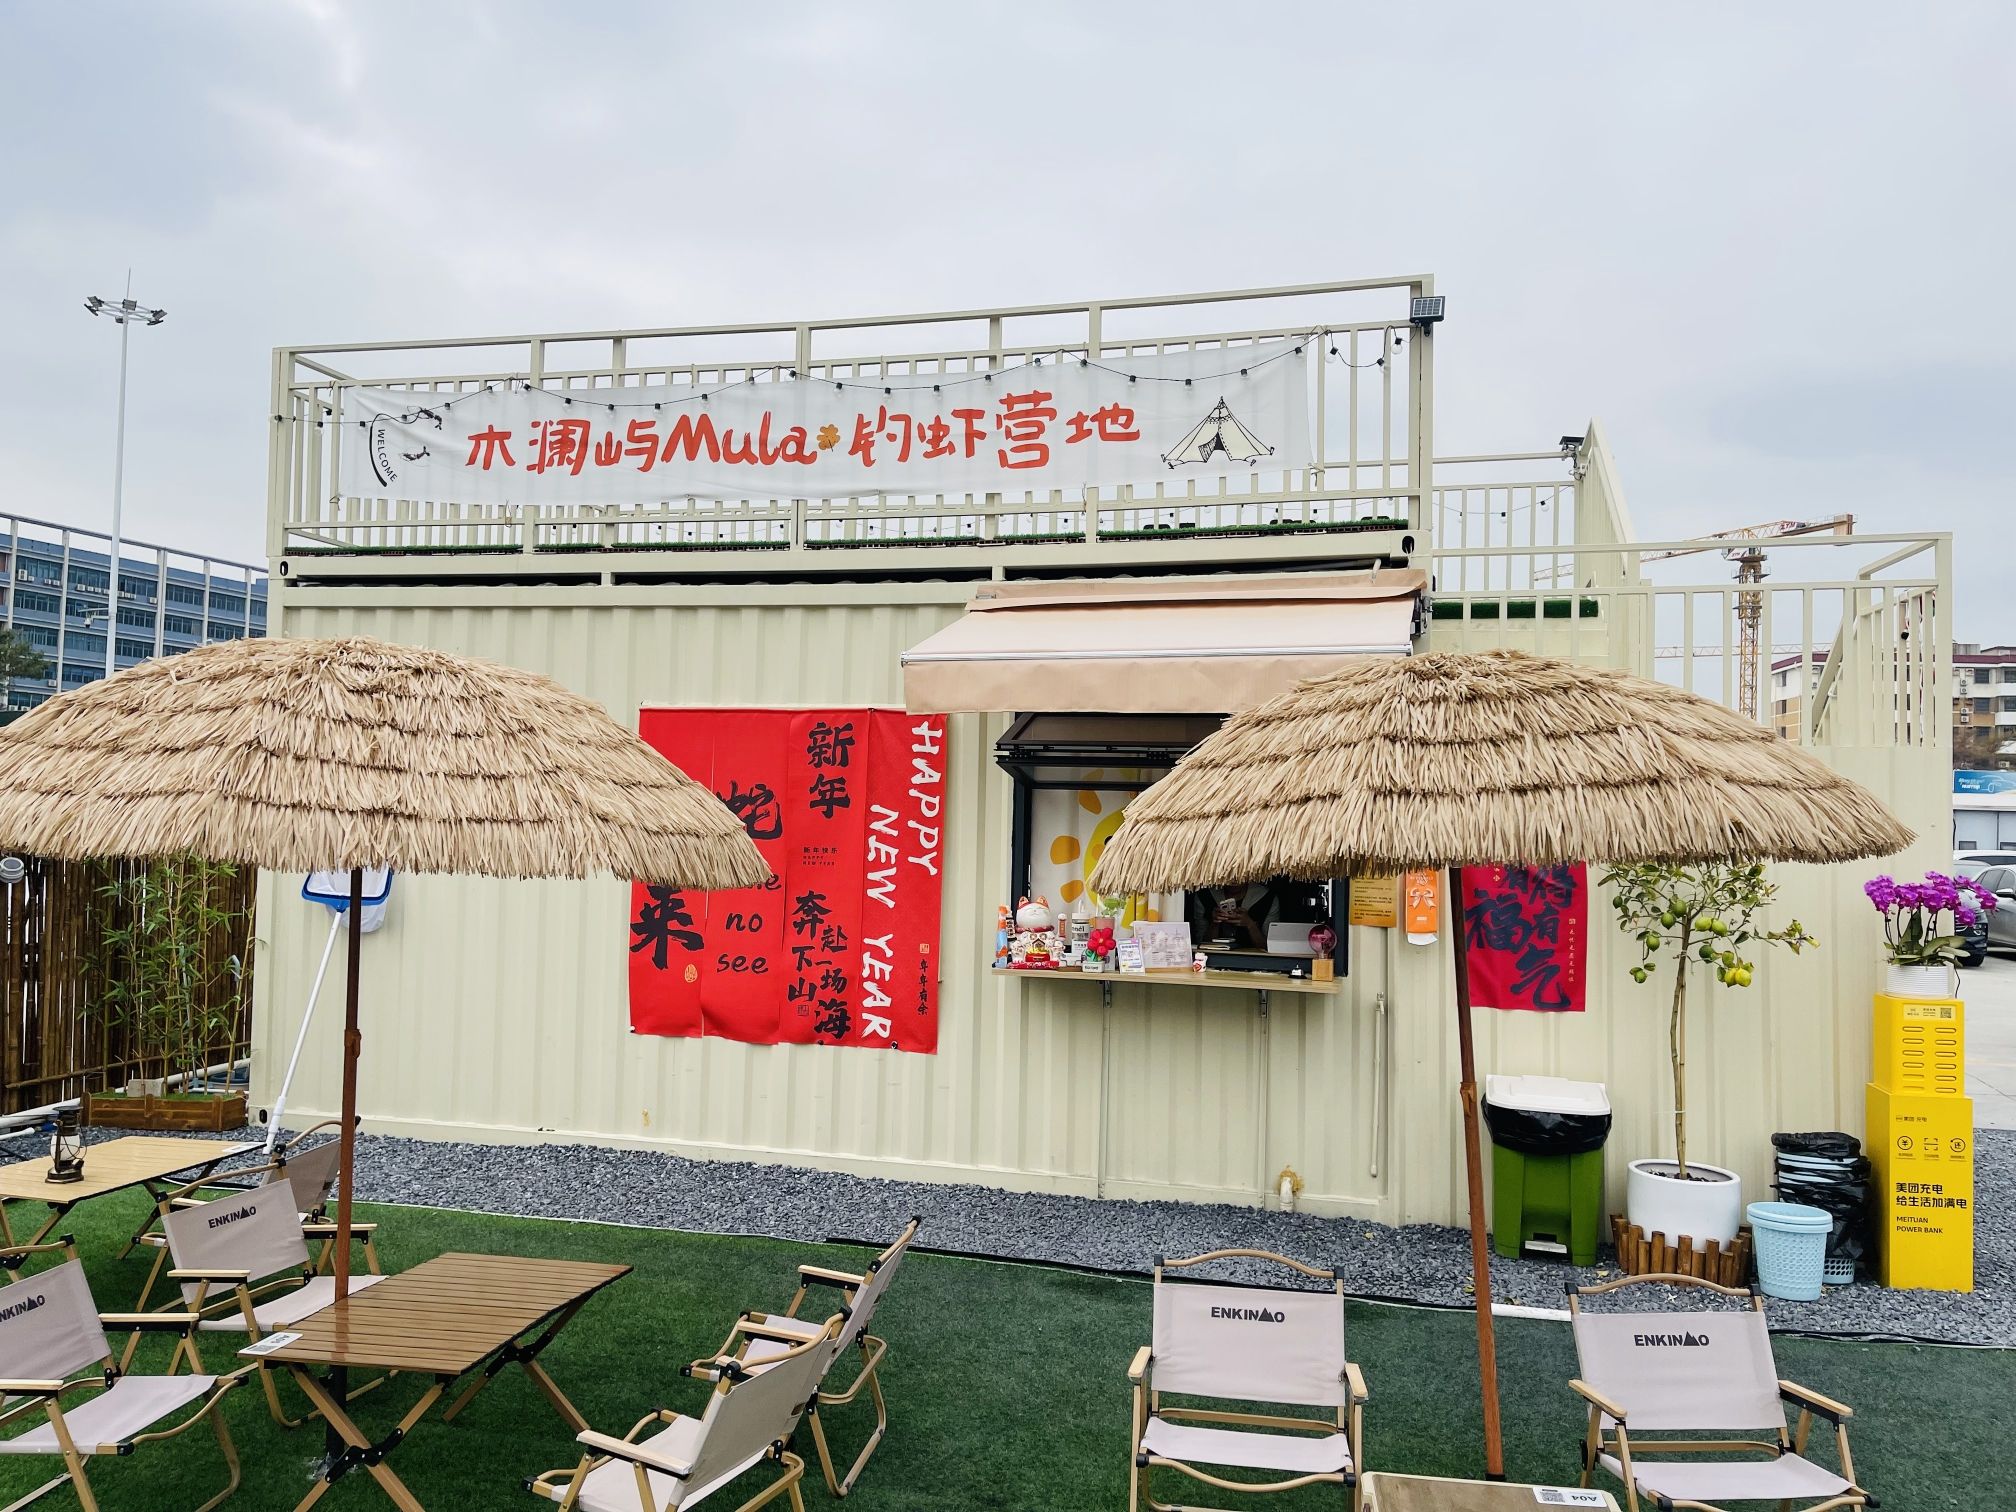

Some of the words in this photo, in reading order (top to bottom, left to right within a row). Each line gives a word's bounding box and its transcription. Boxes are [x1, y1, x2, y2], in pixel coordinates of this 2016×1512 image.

[377, 429, 398, 482] WELCOME
[849, 390, 1140, 470] 钓虾营地
[806, 721, 855, 819] 新年
[907, 720, 942, 877] HAPPY
[866, 804, 900, 909] NEW
[725, 912, 764, 933] no
[716, 953, 769, 974] see
[861, 933, 894, 1039] YEAR
[1896, 1183, 1943, 1194] 美团充电
[1896, 1196, 1967, 1209] 给生活加满电
